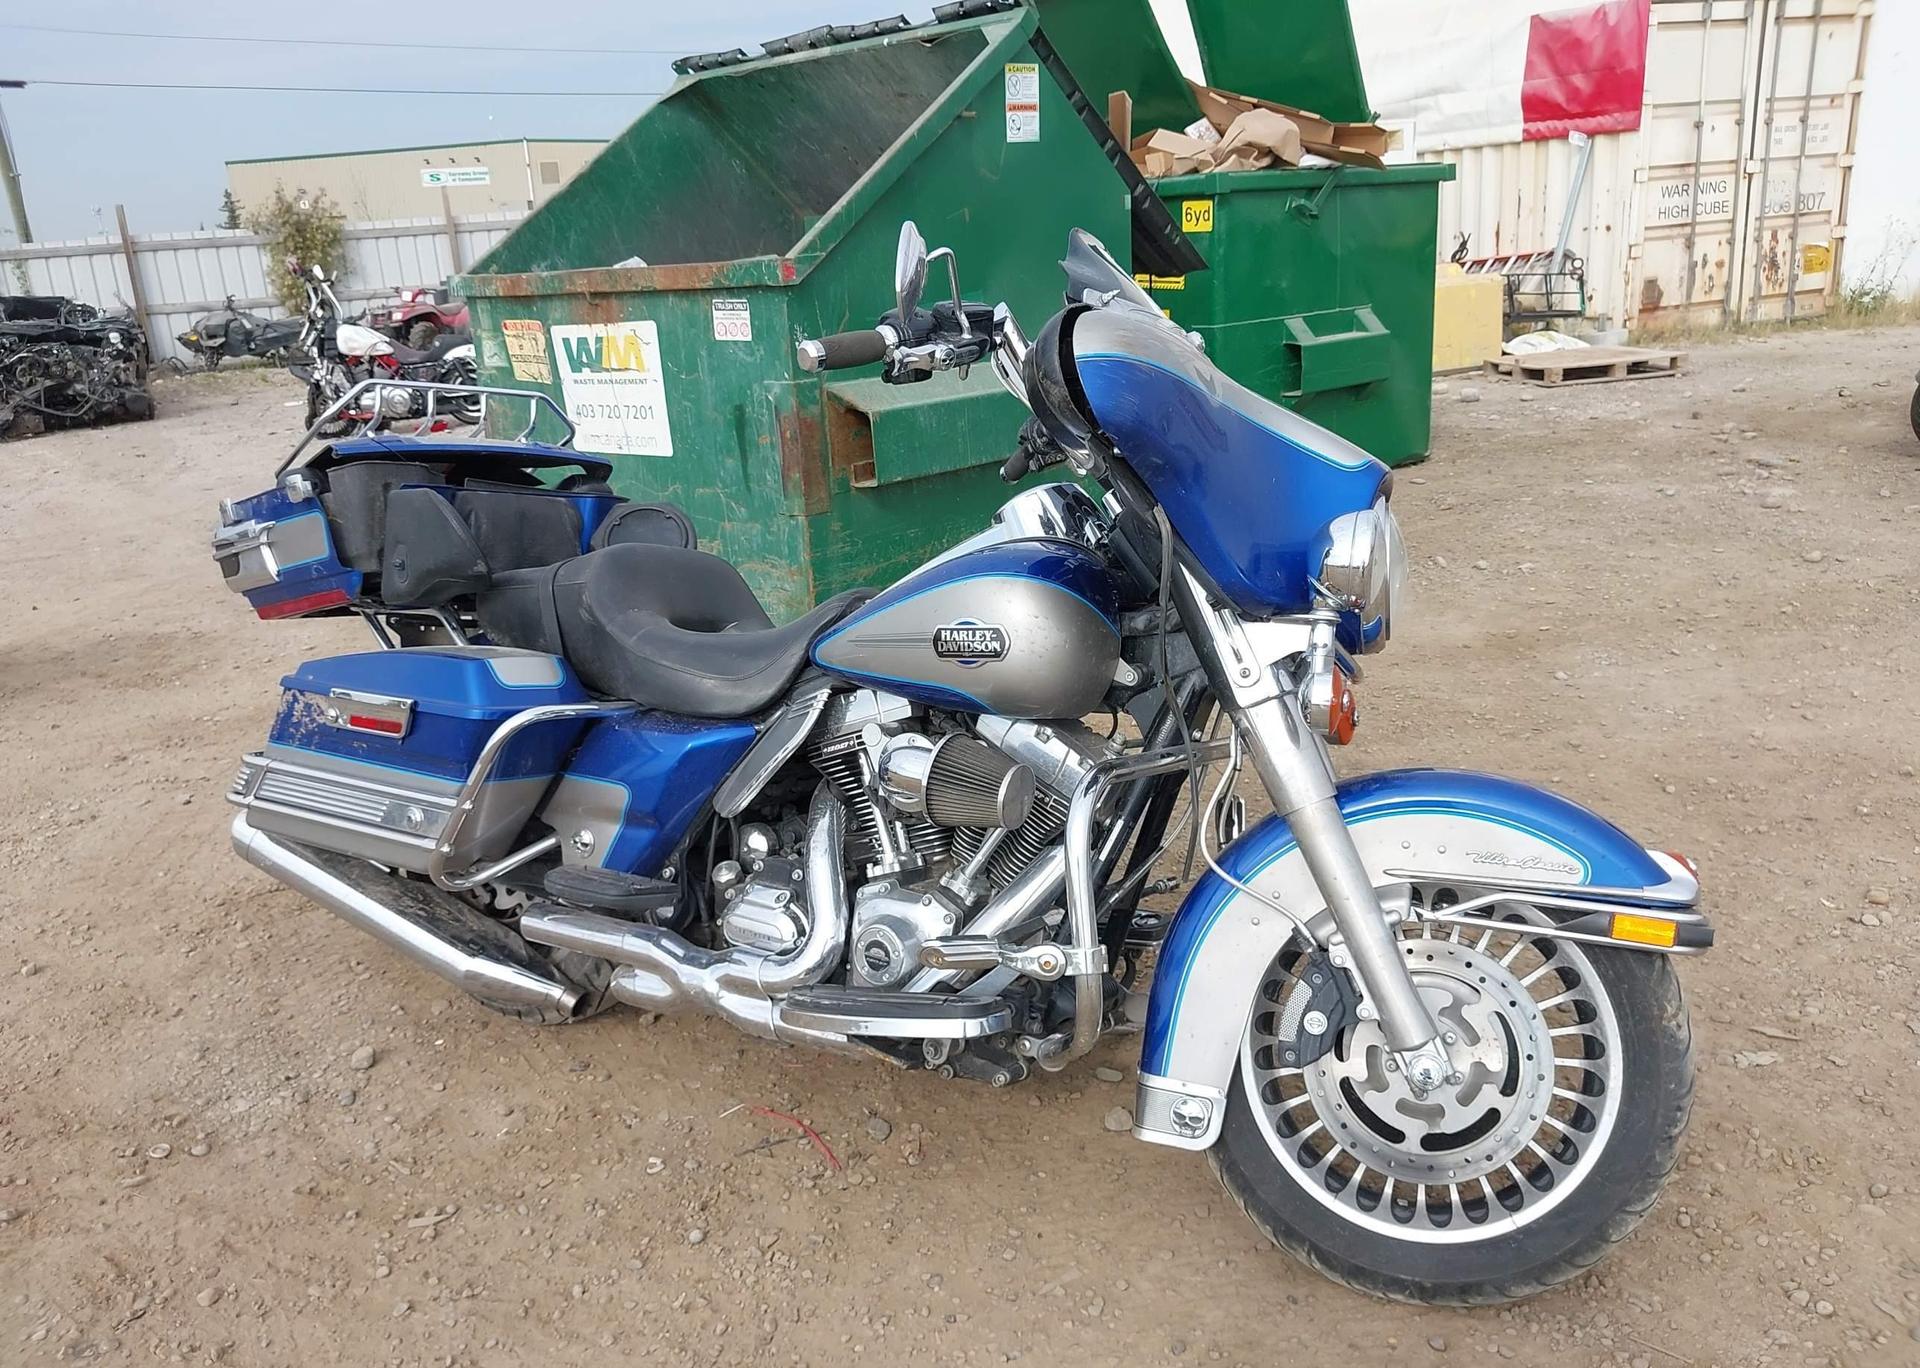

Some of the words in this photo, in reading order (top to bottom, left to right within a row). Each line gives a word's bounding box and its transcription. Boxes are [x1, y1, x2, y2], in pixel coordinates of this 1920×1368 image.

[1011, 103, 1037, 111] WARNING
[429, 173, 441, 182] S
[1661, 180, 1727, 198] WARNING
[1185, 205, 1211, 227] 6yd
[1658, 204, 1689, 220] HIGH
[1696, 200, 1729, 216] CUBE
[561, 336, 648, 374] WM
[576, 404, 596, 418] 403
[598, 404, 621, 419] 720
[623, 404, 654, 420] 7201
[940, 629, 997, 641] HARLEY-
[938, 640, 1001, 652] DAVIDSON
[1465, 850, 1519, 866] Ultra
[1520, 856, 1580, 874] Classic
